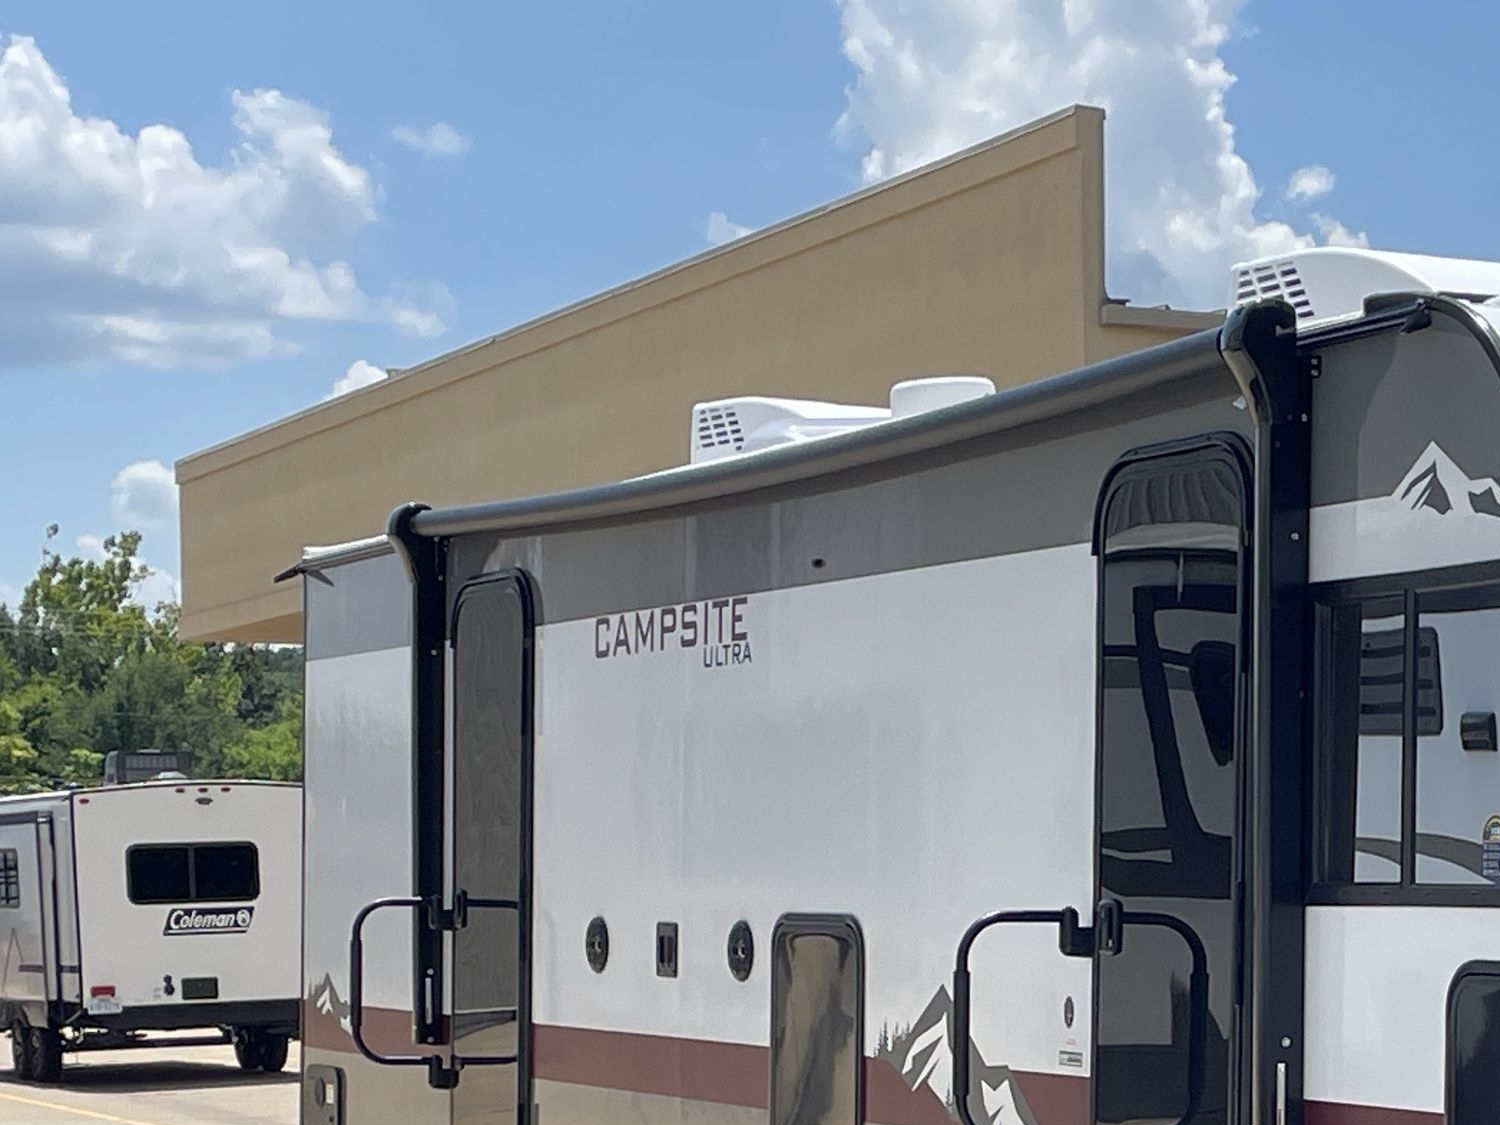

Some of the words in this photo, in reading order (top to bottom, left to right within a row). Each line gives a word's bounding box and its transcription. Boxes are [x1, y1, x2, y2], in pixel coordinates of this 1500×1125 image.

[595, 597, 749, 659] CAMPSITE
[703, 641, 752, 668] ULTRA
[169, 907, 235, 931] Coleman
